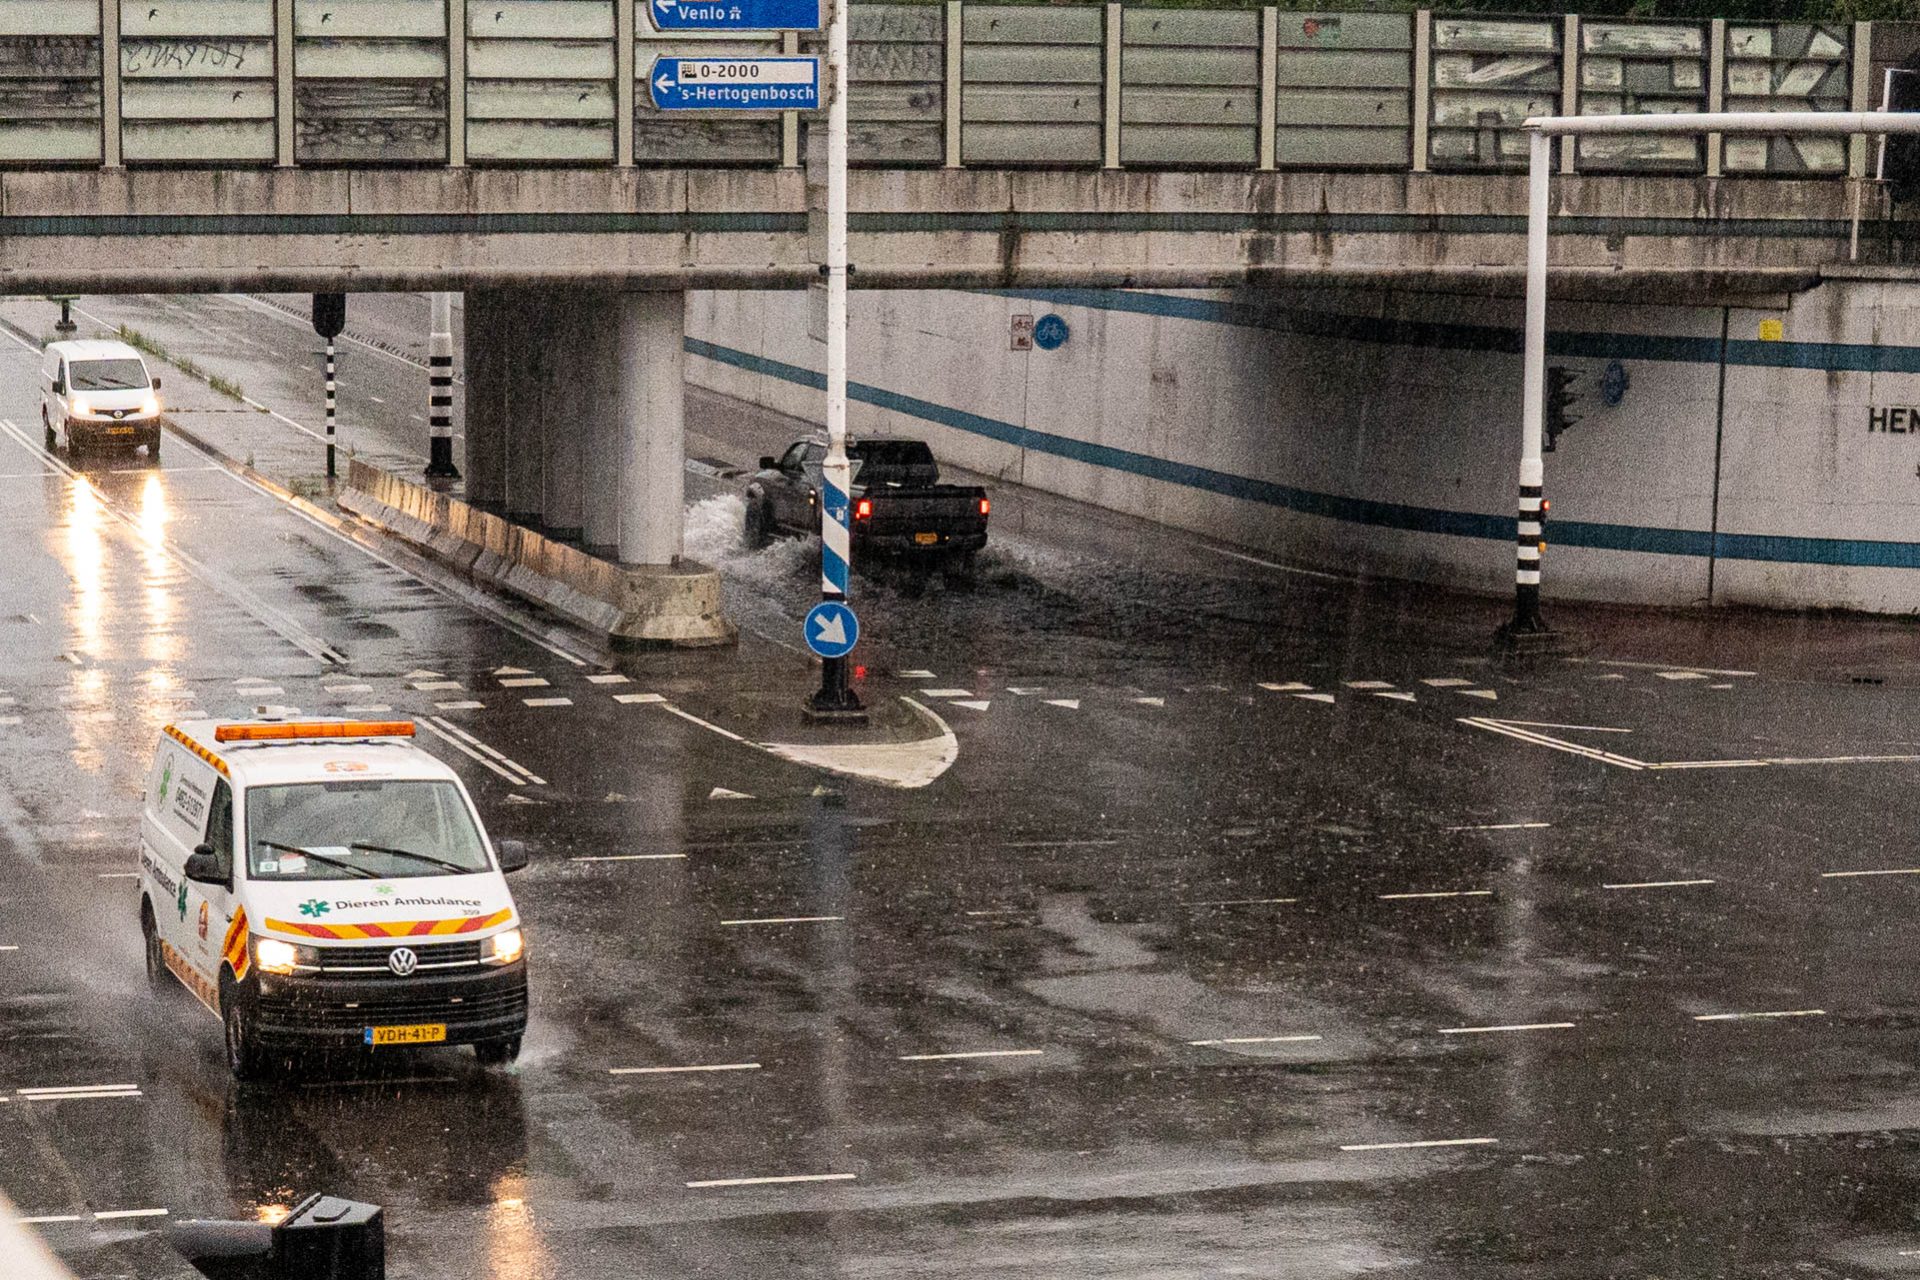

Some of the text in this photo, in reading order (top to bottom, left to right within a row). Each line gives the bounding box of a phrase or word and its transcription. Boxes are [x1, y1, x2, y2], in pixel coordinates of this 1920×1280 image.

[678, 6, 725, 20] Venlo
[701, 64, 759, 78] 0-2000
[678, 86, 814, 103] 's-Hertogenbosch
[336, 896, 482, 910] Dieren Ambulance
[378, 1027, 440, 1041] VDH-41-P
